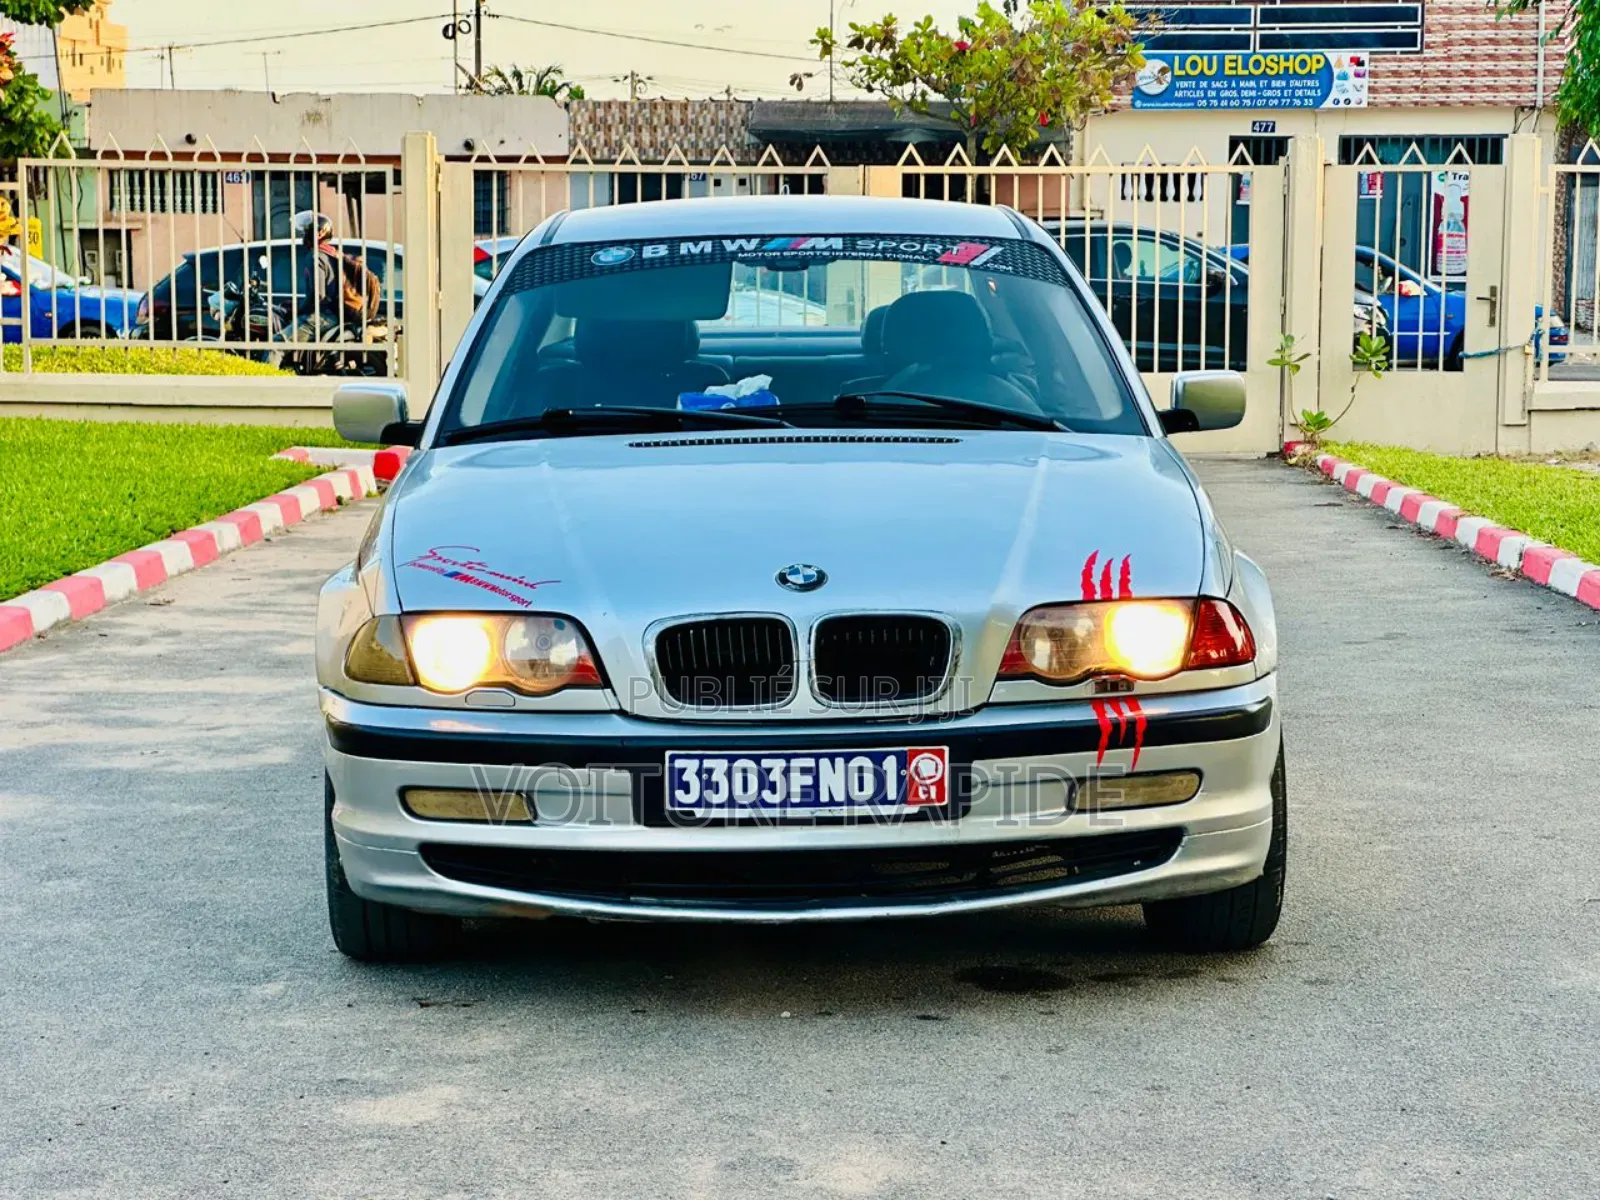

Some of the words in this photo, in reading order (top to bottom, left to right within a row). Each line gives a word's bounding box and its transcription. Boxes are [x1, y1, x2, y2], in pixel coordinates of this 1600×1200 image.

[1174, 55, 1216, 76] LOU
[1224, 54, 1326, 76] ELOSHOP
[1199, 80, 1208, 88] DE
[1211, 80, 1228, 88] SACS
[1260, 80, 1269, 88] ET
[1174, 89, 1204, 98] ARTICLES
[1207, 89, 1217, 97] EN
[1253, 122, 1274, 132] 477
[855, 239, 962, 256] SPORT
[918, 784, 938, 800] CI
